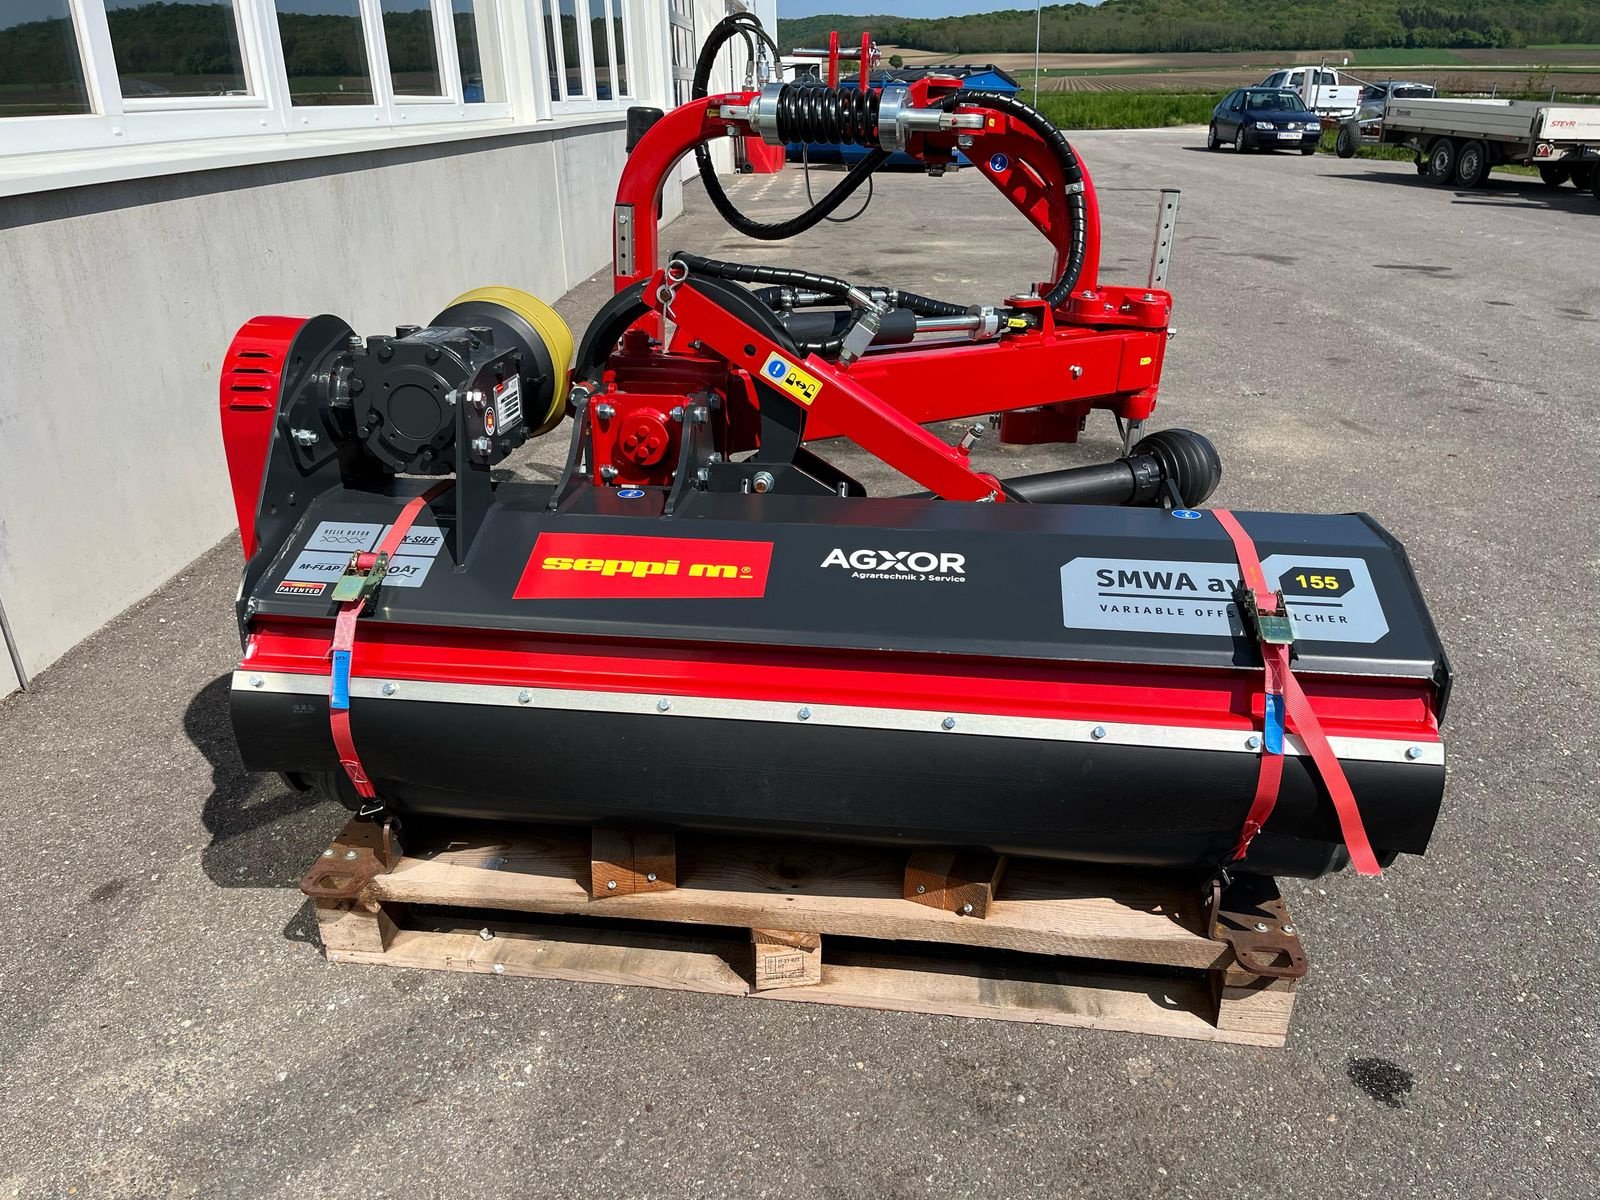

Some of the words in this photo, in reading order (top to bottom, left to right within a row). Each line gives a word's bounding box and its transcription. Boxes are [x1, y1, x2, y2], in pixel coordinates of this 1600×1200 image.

[1551, 120, 1577, 128] STEYR
[541, 557, 681, 578] seppi
[820, 548, 966, 574] AGXOR
[851, 571, 917, 581] Agrartechnik
[928, 574, 966, 583] Service
[1096, 569, 1198, 591] SMWA
[1296, 574, 1340, 590] 155
[278, 586, 321, 594] PATENTED
[1099, 604, 1185, 616] VARIABLE
